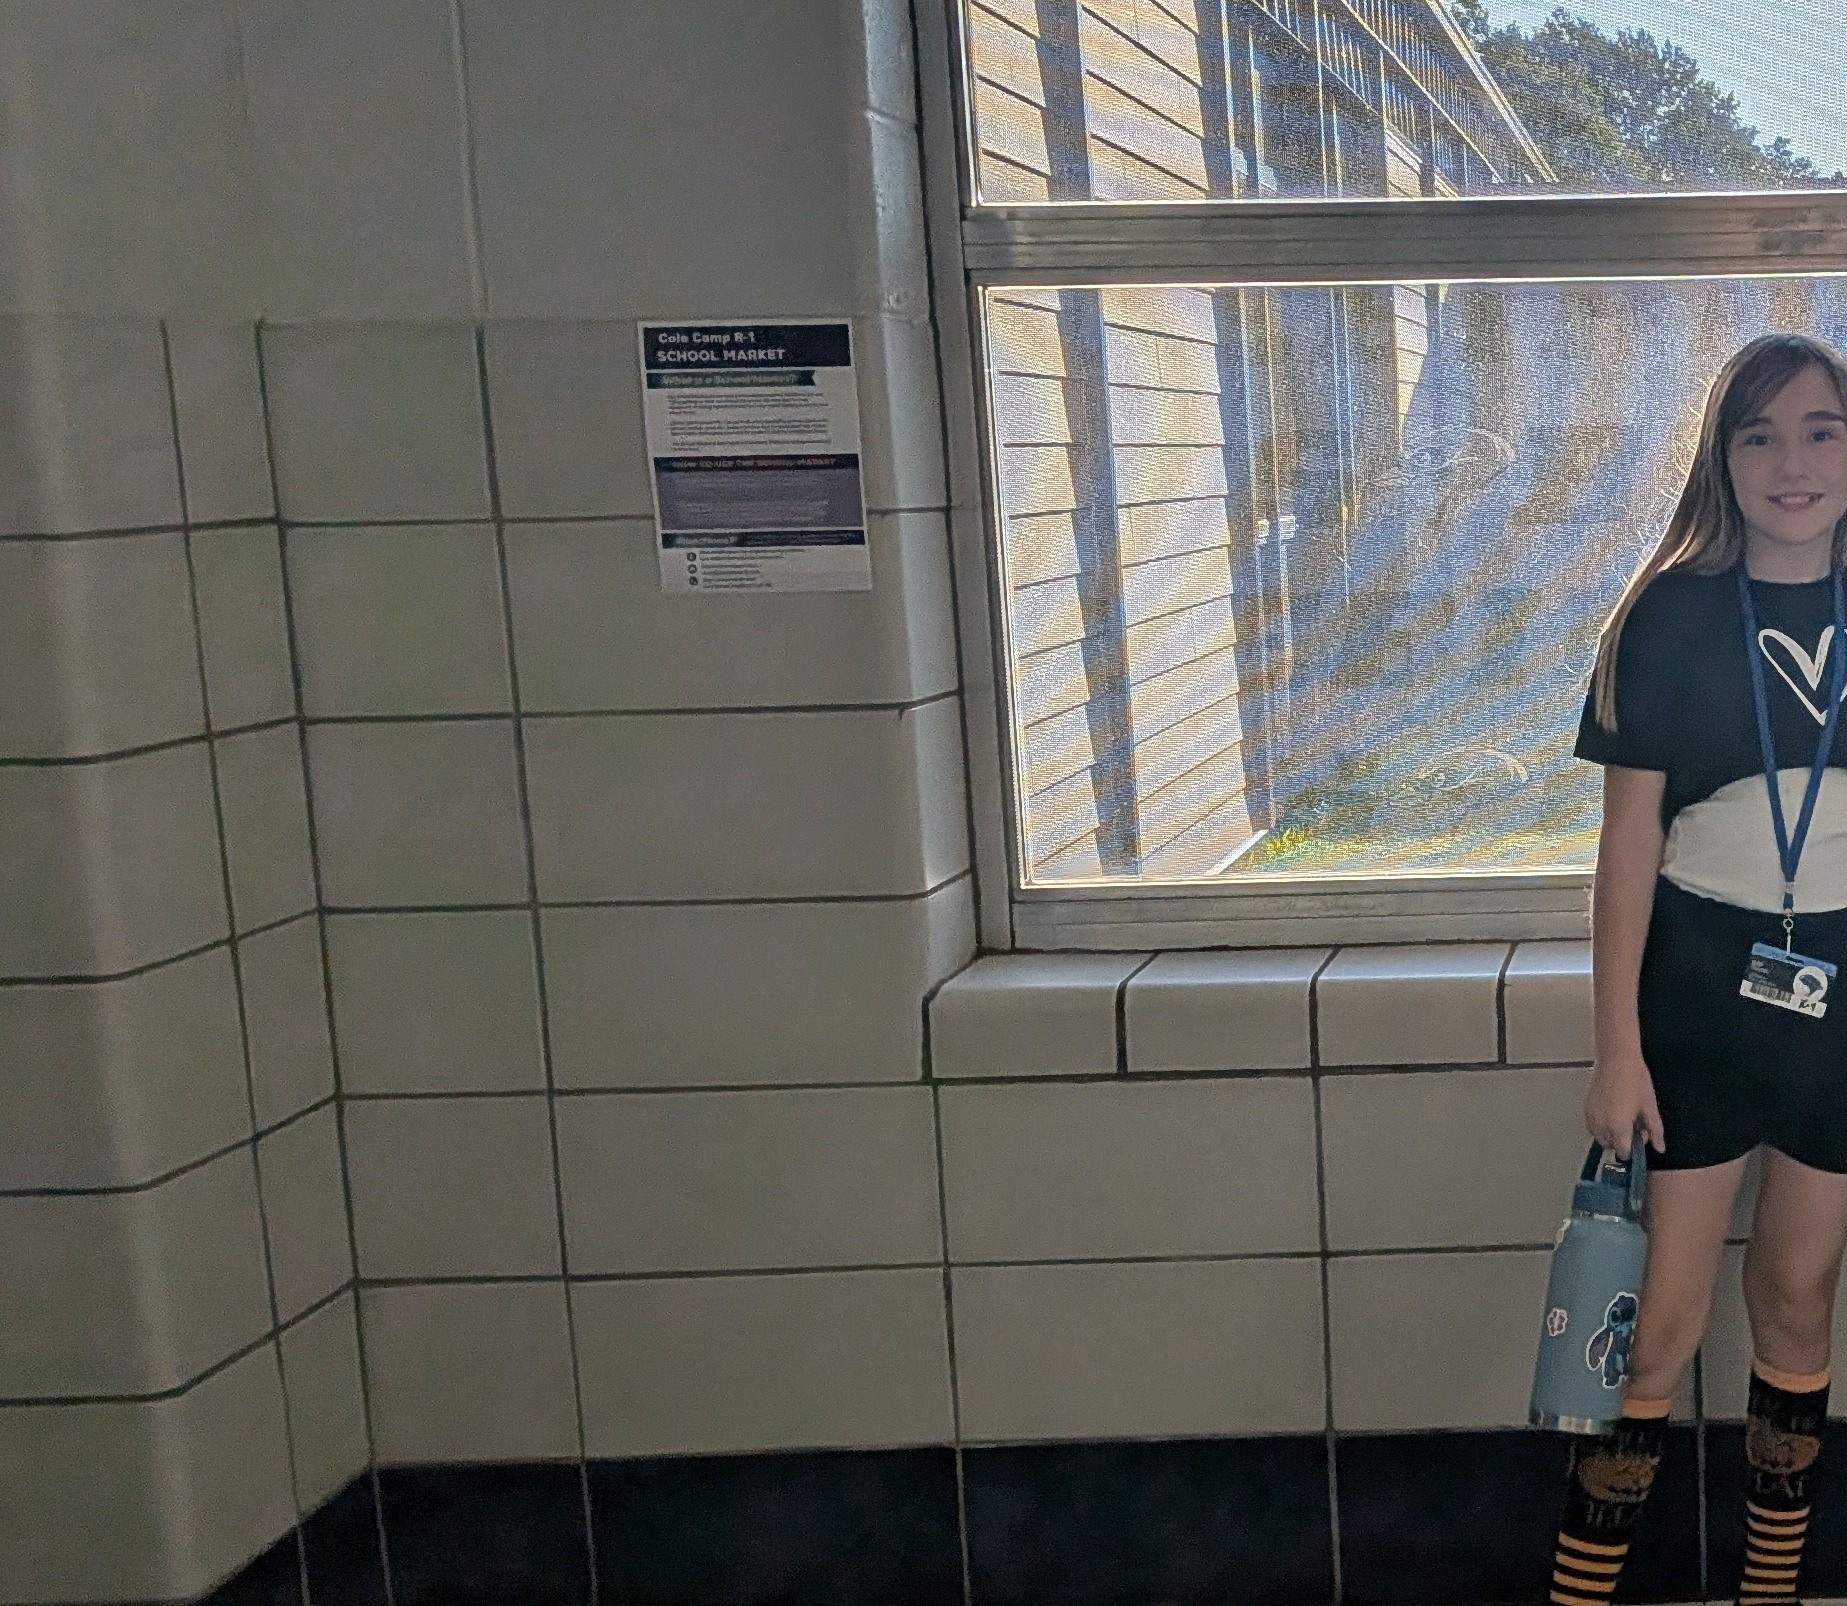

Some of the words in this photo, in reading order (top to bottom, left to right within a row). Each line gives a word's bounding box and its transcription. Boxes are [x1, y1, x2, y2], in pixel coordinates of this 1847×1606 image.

[658, 332, 690, 344] Cole
[692, 331, 731, 345] Camp
[733, 331, 756, 344] R-1
[656, 350, 719, 362] SCHOOL
[722, 349, 786, 361] MARKET
